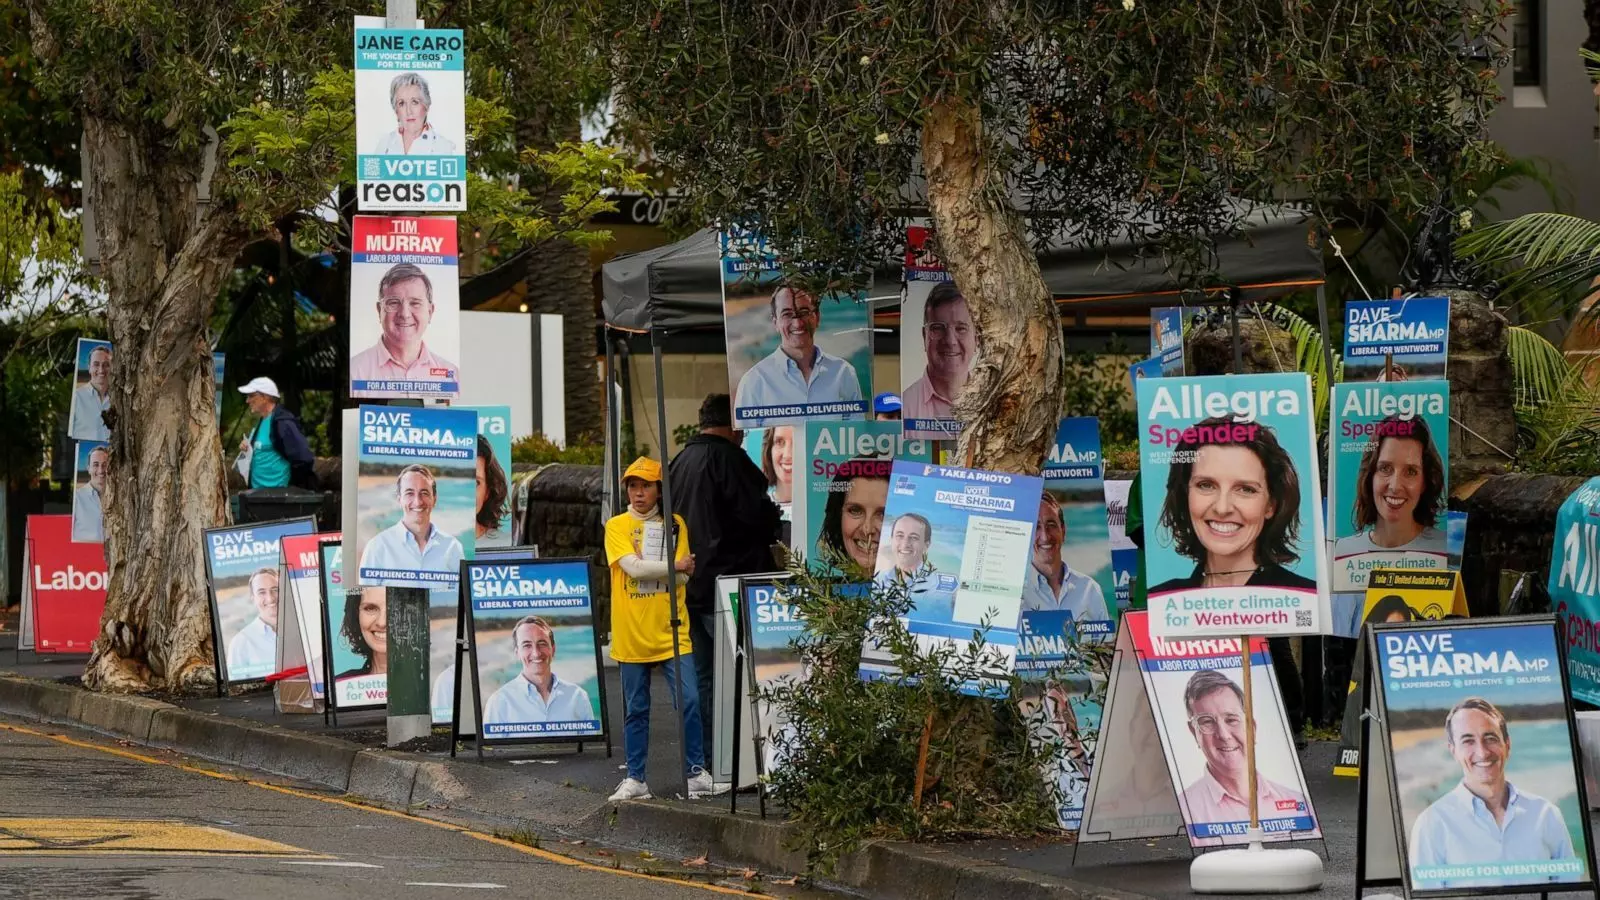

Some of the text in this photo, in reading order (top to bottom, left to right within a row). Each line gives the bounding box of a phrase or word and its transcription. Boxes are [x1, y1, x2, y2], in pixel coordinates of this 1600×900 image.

[358, 36, 462, 51] JANE CARO
[417, 53, 453, 61] reason
[377, 61, 442, 69] FOR THE SENATE
[384, 159, 438, 176] VOTE
[363, 183, 462, 203] reason
[631, 197, 678, 223] COF
[391, 220, 418, 234] TIM
[366, 234, 444, 253] MURRAY
[366, 254, 444, 264] LABOR FOR WENTWORTH
[931, 271, 944, 280] FOR
[1349, 307, 1390, 324] DAVE
[1347, 321, 1444, 342] SHARMA MP
[1351, 344, 1439, 355] LIBERAL FOR WENTWORTH
[366, 381, 442, 391] FOR A BETTER FUTURE
[741, 403, 863, 418] EXPERIENCED. DELIVERING.
[1147, 384, 1300, 423] Allegra
[1341, 388, 1444, 421] Allegra
[364, 411, 411, 426] DAVE
[915, 421, 927, 430] FOR
[363, 425, 474, 447] SHARMA MP
[1148, 423, 1258, 448] Spender
[1341, 420, 1416, 440] Spender
[812, 426, 926, 461] Allegra
[368, 445, 468, 458] LIBERAL FOR WENTWORTH
[1078, 451, 1097, 462] MP
[939, 468, 1012, 484] TAKE A PHOTO
[966, 486, 988, 496] VOTE
[936, 492, 965, 504] DAVE
[965, 496, 1012, 509] SHARMA
[212, 530, 254, 546] DAVE
[214, 539, 280, 560] SHARM
[1346, 558, 1436, 570] A better climate
[303, 569, 320, 578] LABO
[365, 570, 460, 582] EXPERIENCED. DELIVERIN
[471, 565, 521, 580] DAVE
[1350, 572, 1366, 583] for
[472, 578, 587, 598] SHARMA MP
[479, 598, 583, 609] LIBERAL FOR WENTWORTH
[1165, 594, 1301, 611] A better climate
[756, 604, 806, 623] SHA
[1165, 610, 1289, 627] for Wentworth
[1385, 633, 1455, 655] DAVE
[1157, 656, 1245, 671] LABOR FOR WENTWORT
[1387, 650, 1549, 679] SHARMA MP
[346, 679, 388, 690] A bette
[1401, 675, 1552, 689] EXPERIENCED EFFECTIVE DELIVERS
[346, 691, 362, 701] for
[489, 722, 595, 733] EXPERIENCED. DELIVERING.
[1341, 749, 1359, 765] FOR
[1208, 819, 1297, 835] FOR A BETT FUTURE
[1416, 862, 1581, 880] WORKING FOR WENTWORTH
